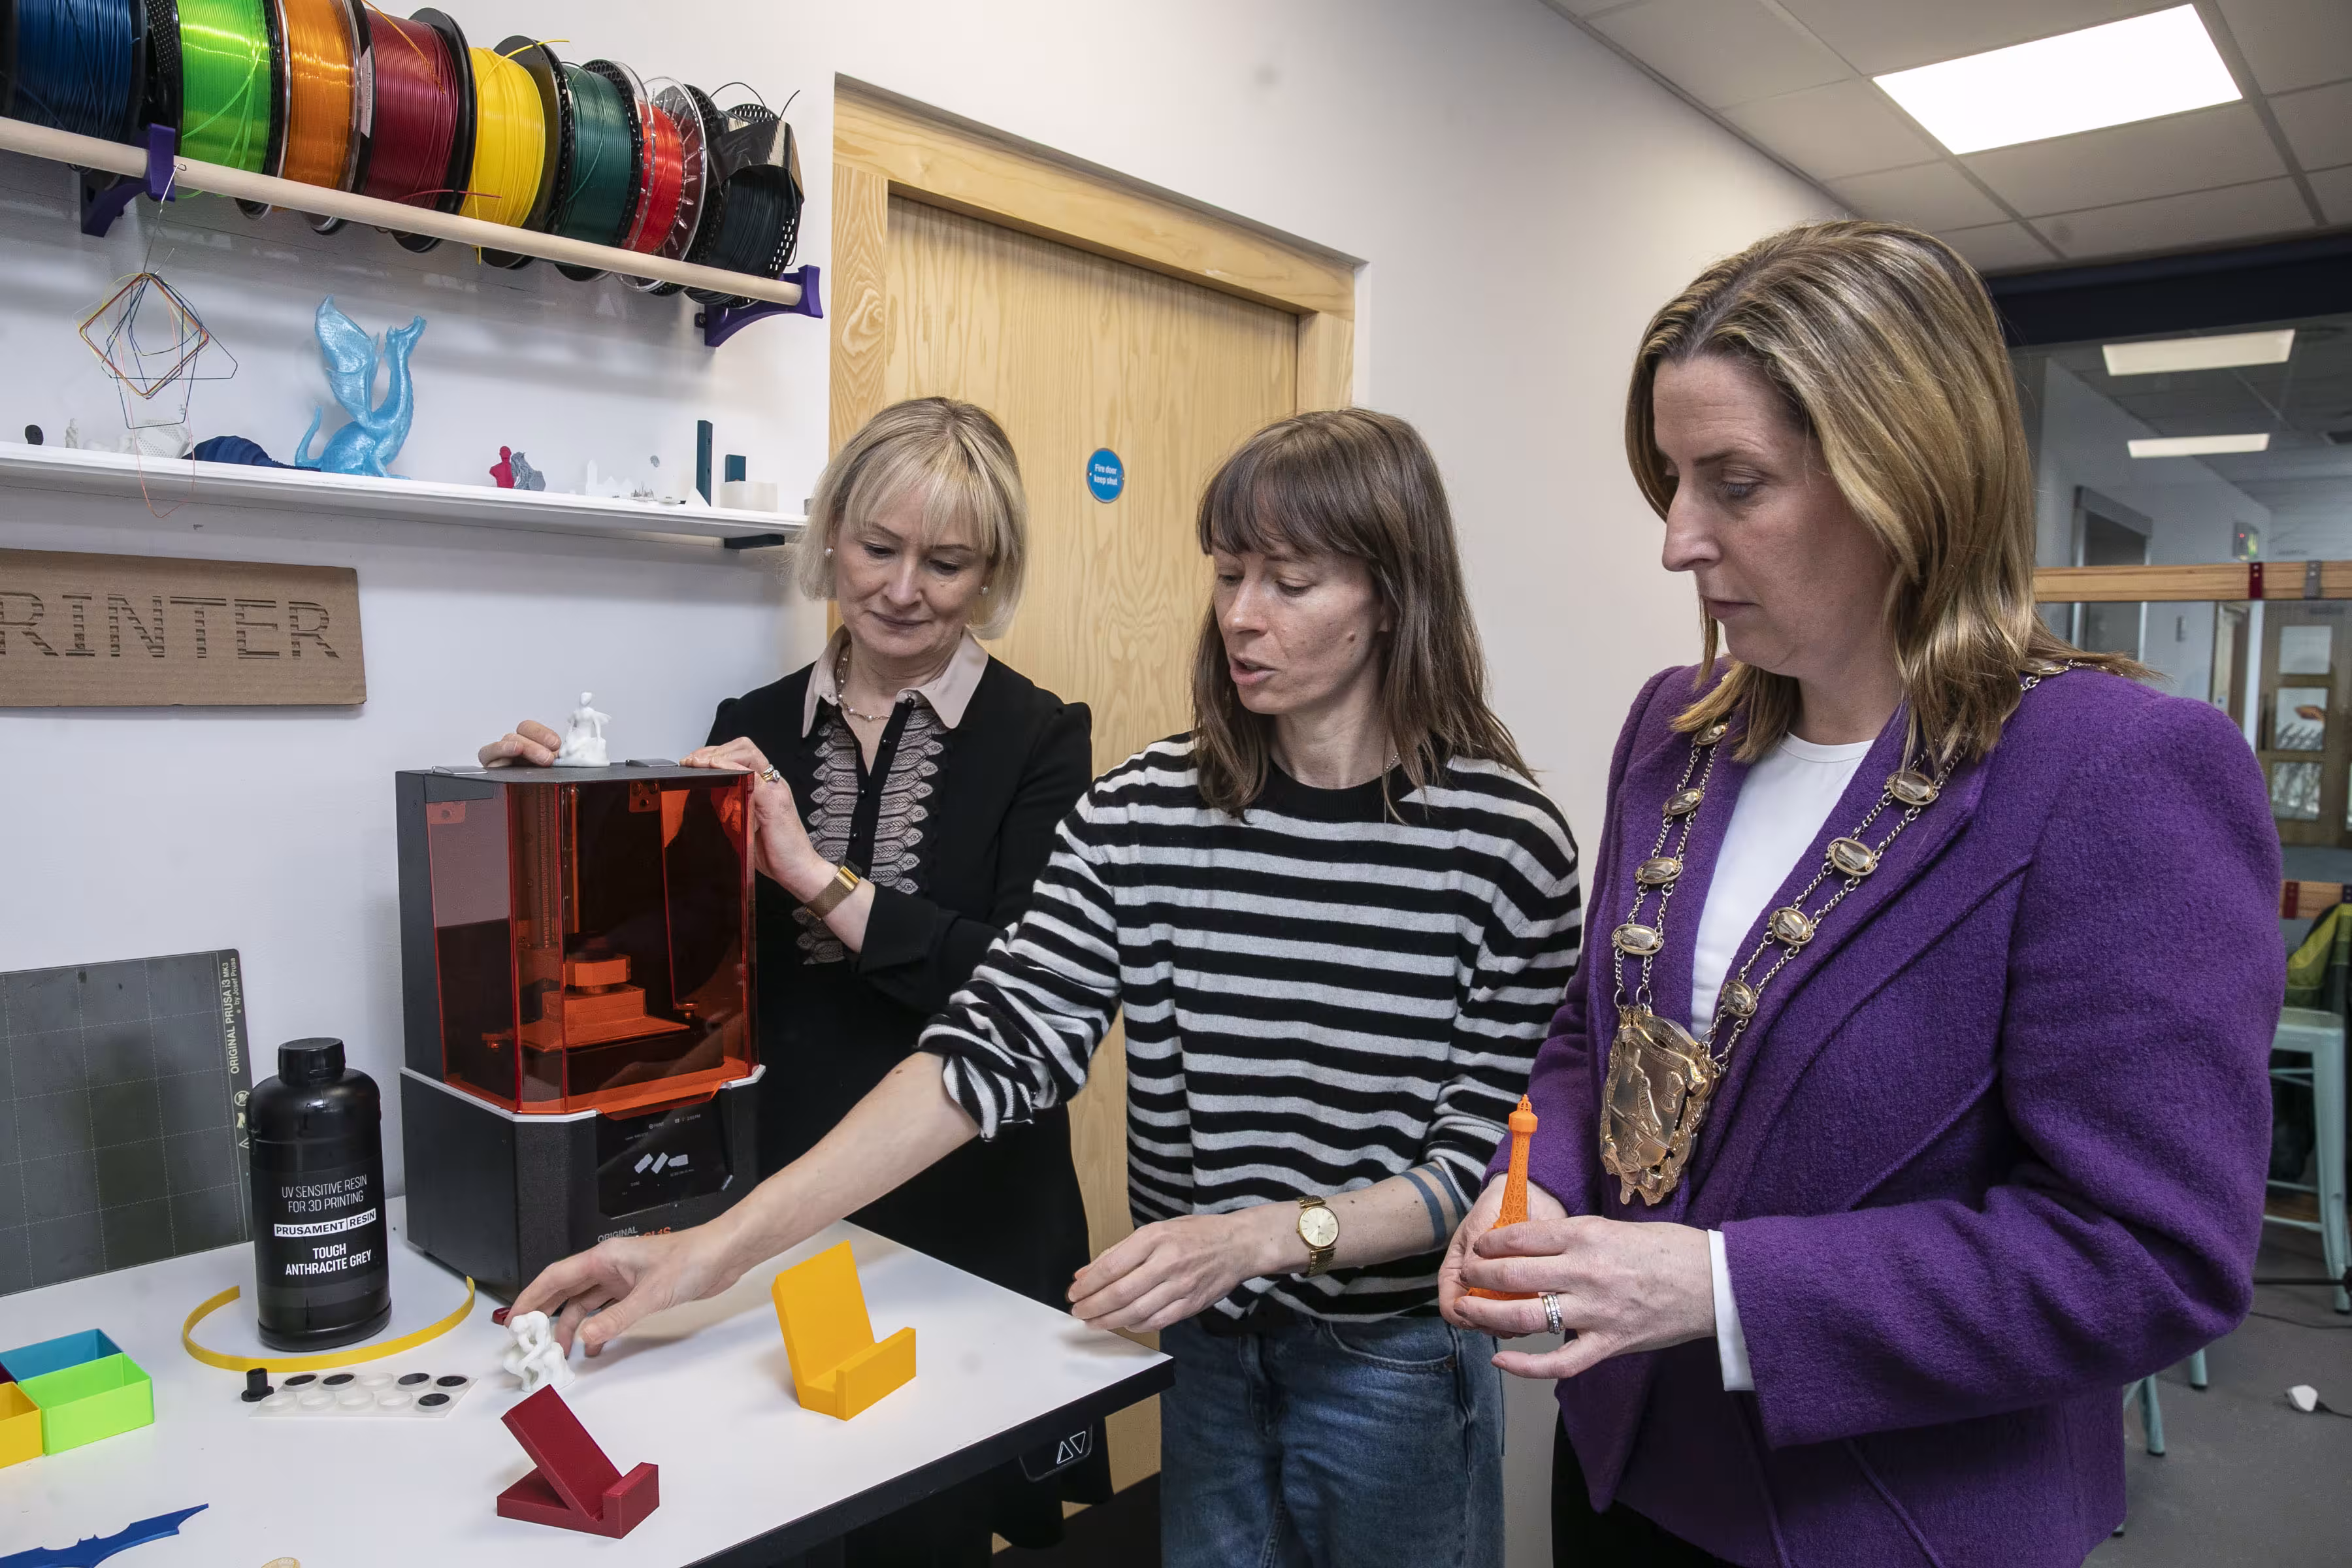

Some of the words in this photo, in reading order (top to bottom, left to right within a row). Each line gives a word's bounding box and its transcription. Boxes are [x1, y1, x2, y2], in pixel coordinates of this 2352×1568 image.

[1094, 474, 1106, 485] keep
[1107, 477, 1117, 485] shut
[1095, 463, 1105, 472] Fire
[1105, 465, 1117, 474] door
[0, 592, 340, 659] RINTER
[221, 979, 231, 988] i3
[223, 989, 235, 1024] PRUSA
[234, 997, 241, 1005] by
[226, 1026, 240, 1074] ORIGINAL
[282, 1186, 294, 1198] UV
[295, 1181, 342, 1198] SENSITIVE
[344, 1174, 367, 1192] RESIN
[288, 1201, 306, 1213] FOR
[308, 1200, 321, 1212] 3D
[324, 1190, 364, 1210] PRINTING
[276, 1220, 345, 1235] PRUSAMENT
[350, 1210, 375, 1227] RESIN
[597, 1226, 638, 1243] ORIGINAL
[286, 1257, 348, 1275] ANTHRACITE
[350, 1249, 371, 1267] GREY
[312, 1243, 346, 1260] TOUGH
